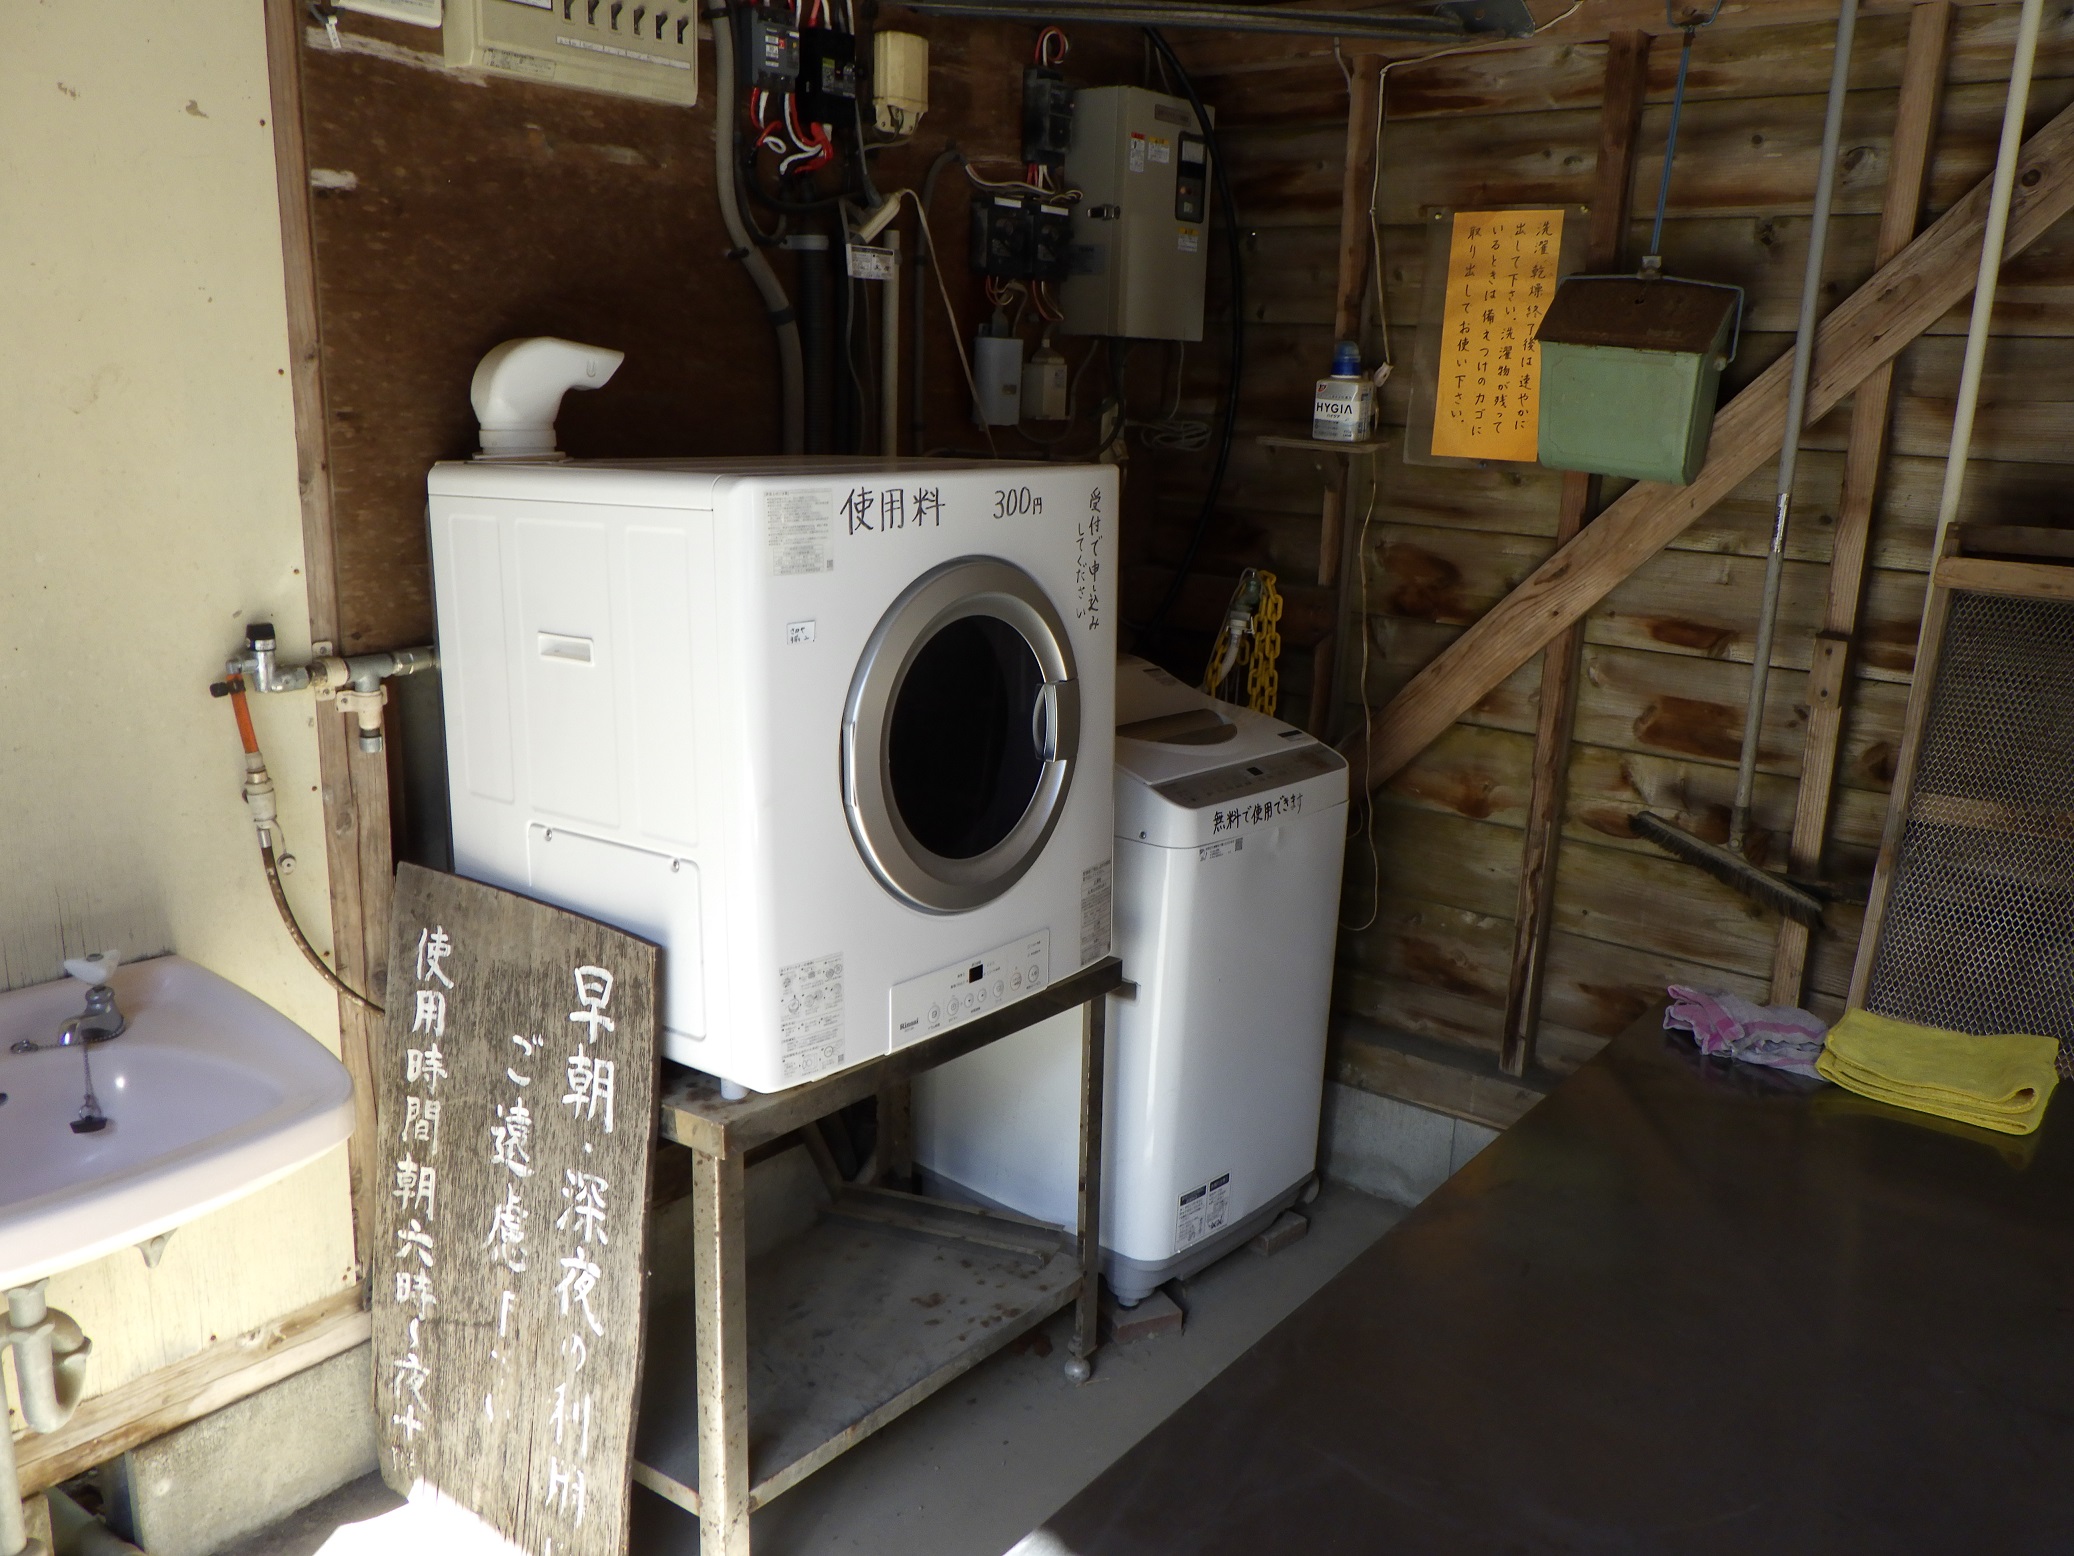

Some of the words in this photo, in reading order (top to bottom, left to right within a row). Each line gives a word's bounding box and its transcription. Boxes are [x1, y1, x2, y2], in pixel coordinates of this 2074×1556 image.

[1471, 224, 1504, 435] いるときは備えつけのカゴに
[1316, 402, 1352, 415] HYGIA
[839, 485, 945, 536] 使用料
[992, 486, 1044, 520] 300円
[1075, 522, 1087, 619] してください
[1088, 486, 1103, 631] 受付で申し込み
[1212, 793, 1304, 835] 無料で使用できます
